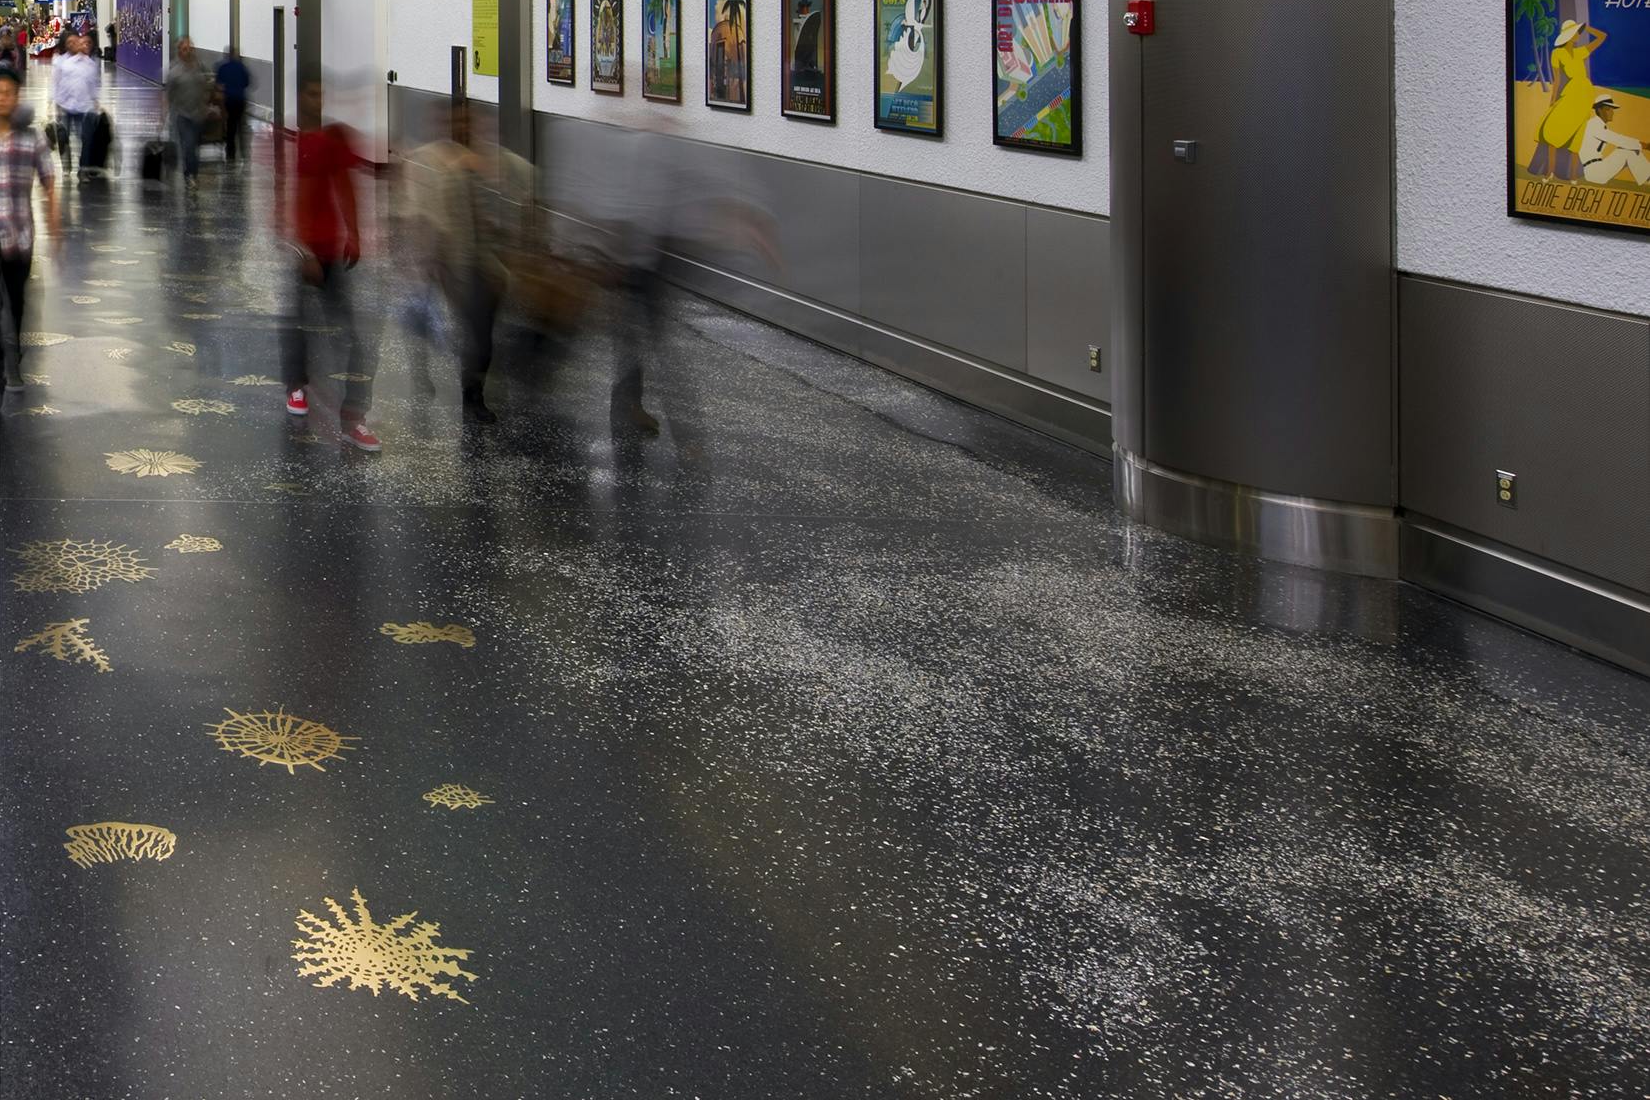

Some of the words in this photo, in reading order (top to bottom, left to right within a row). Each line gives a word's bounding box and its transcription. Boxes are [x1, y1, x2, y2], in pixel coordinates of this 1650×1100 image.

[997, 23, 1014, 53] ART
[1521, 181, 1564, 209] COME
[1563, 186, 1605, 214] BACK
[1606, 190, 1628, 218] TO
